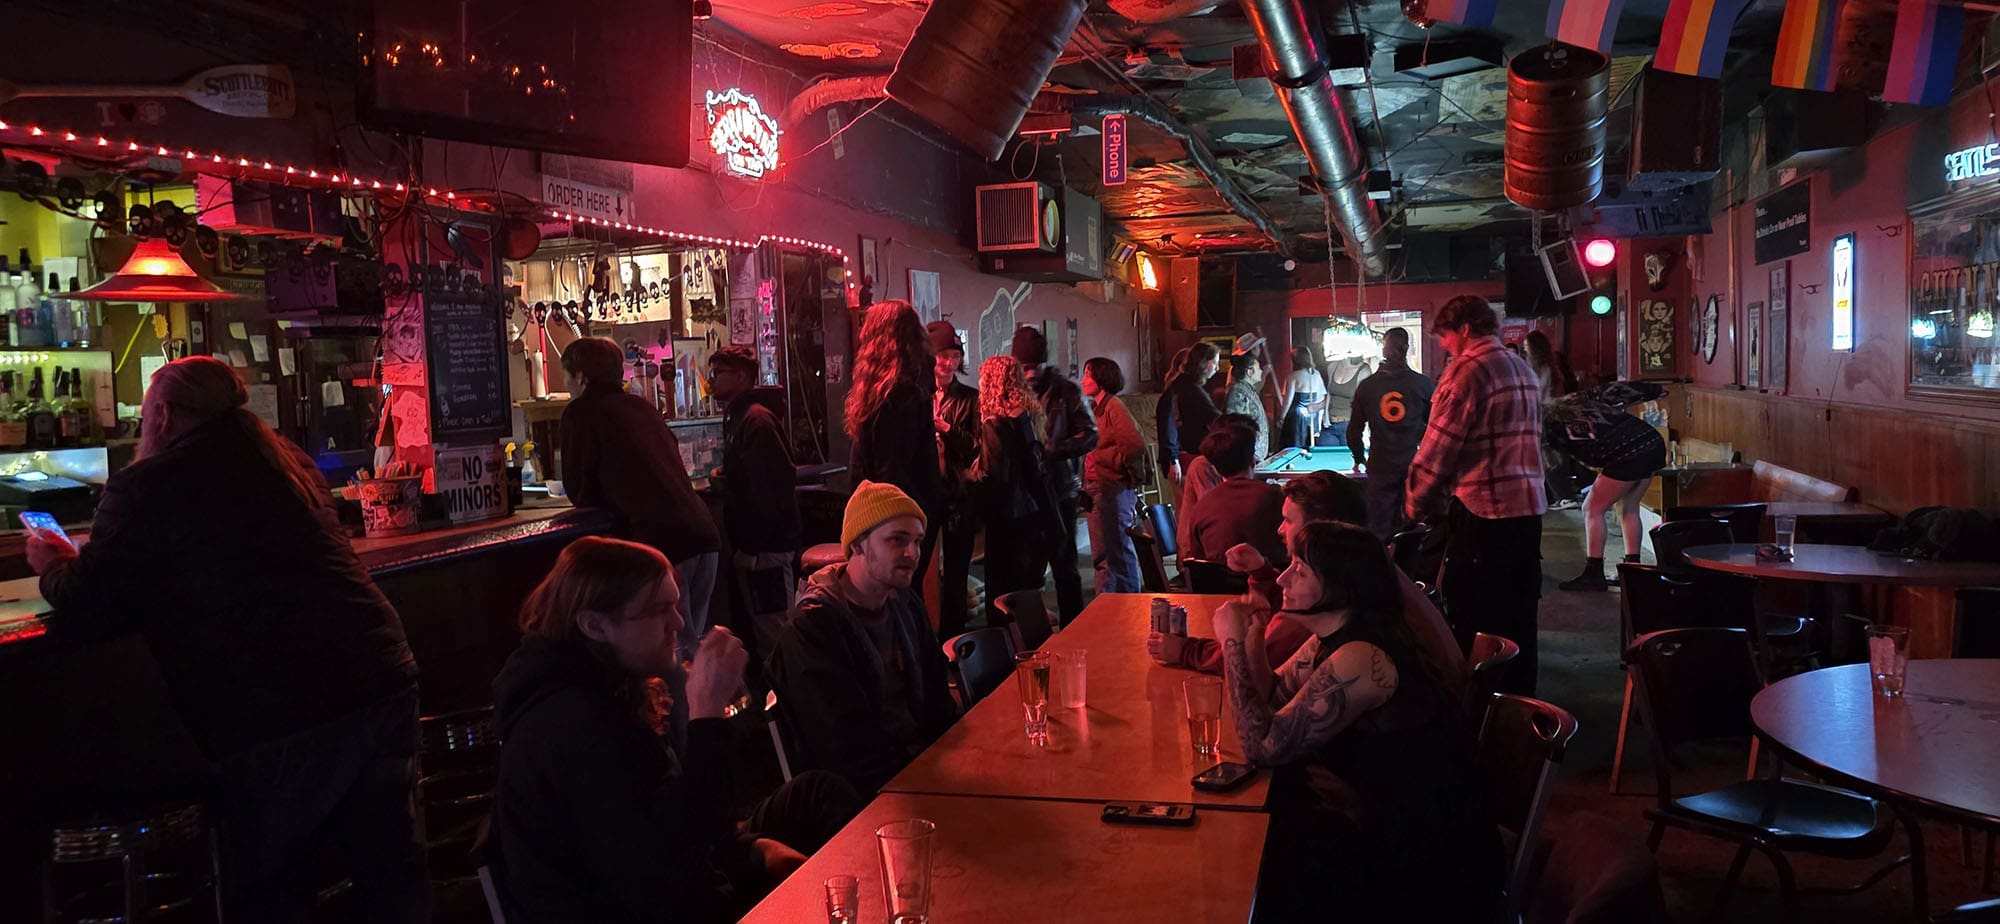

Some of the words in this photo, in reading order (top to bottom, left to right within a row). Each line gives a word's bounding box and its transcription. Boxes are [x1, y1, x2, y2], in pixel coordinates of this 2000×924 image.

[1109, 133, 1121, 178] Phone
[548, 182, 583, 208] ORDER
[586, 190, 610, 213] HERE
[1381, 391, 1406, 422] 6
[462, 456, 482, 481] NO
[444, 484, 502, 513] MINORS
